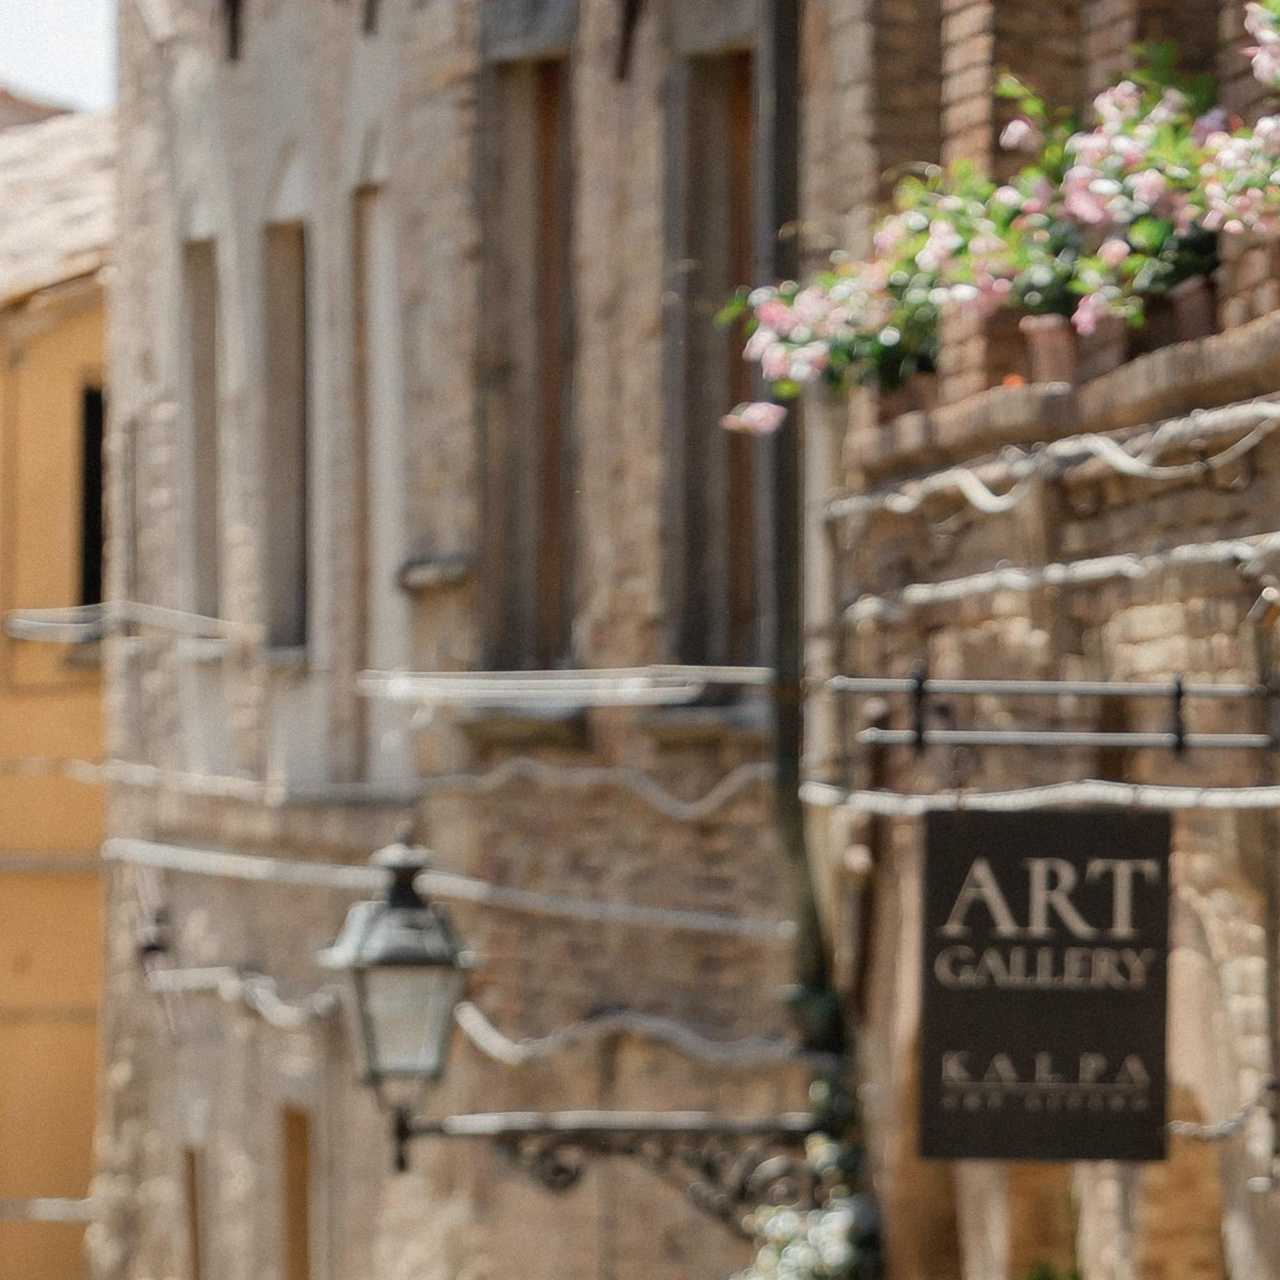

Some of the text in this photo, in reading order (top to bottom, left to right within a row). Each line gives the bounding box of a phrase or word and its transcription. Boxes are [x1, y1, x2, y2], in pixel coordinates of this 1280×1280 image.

[937, 855, 1160, 938] ART
[934, 946, 1156, 990] GALLERY
[941, 1051, 1150, 1084] KALPA
